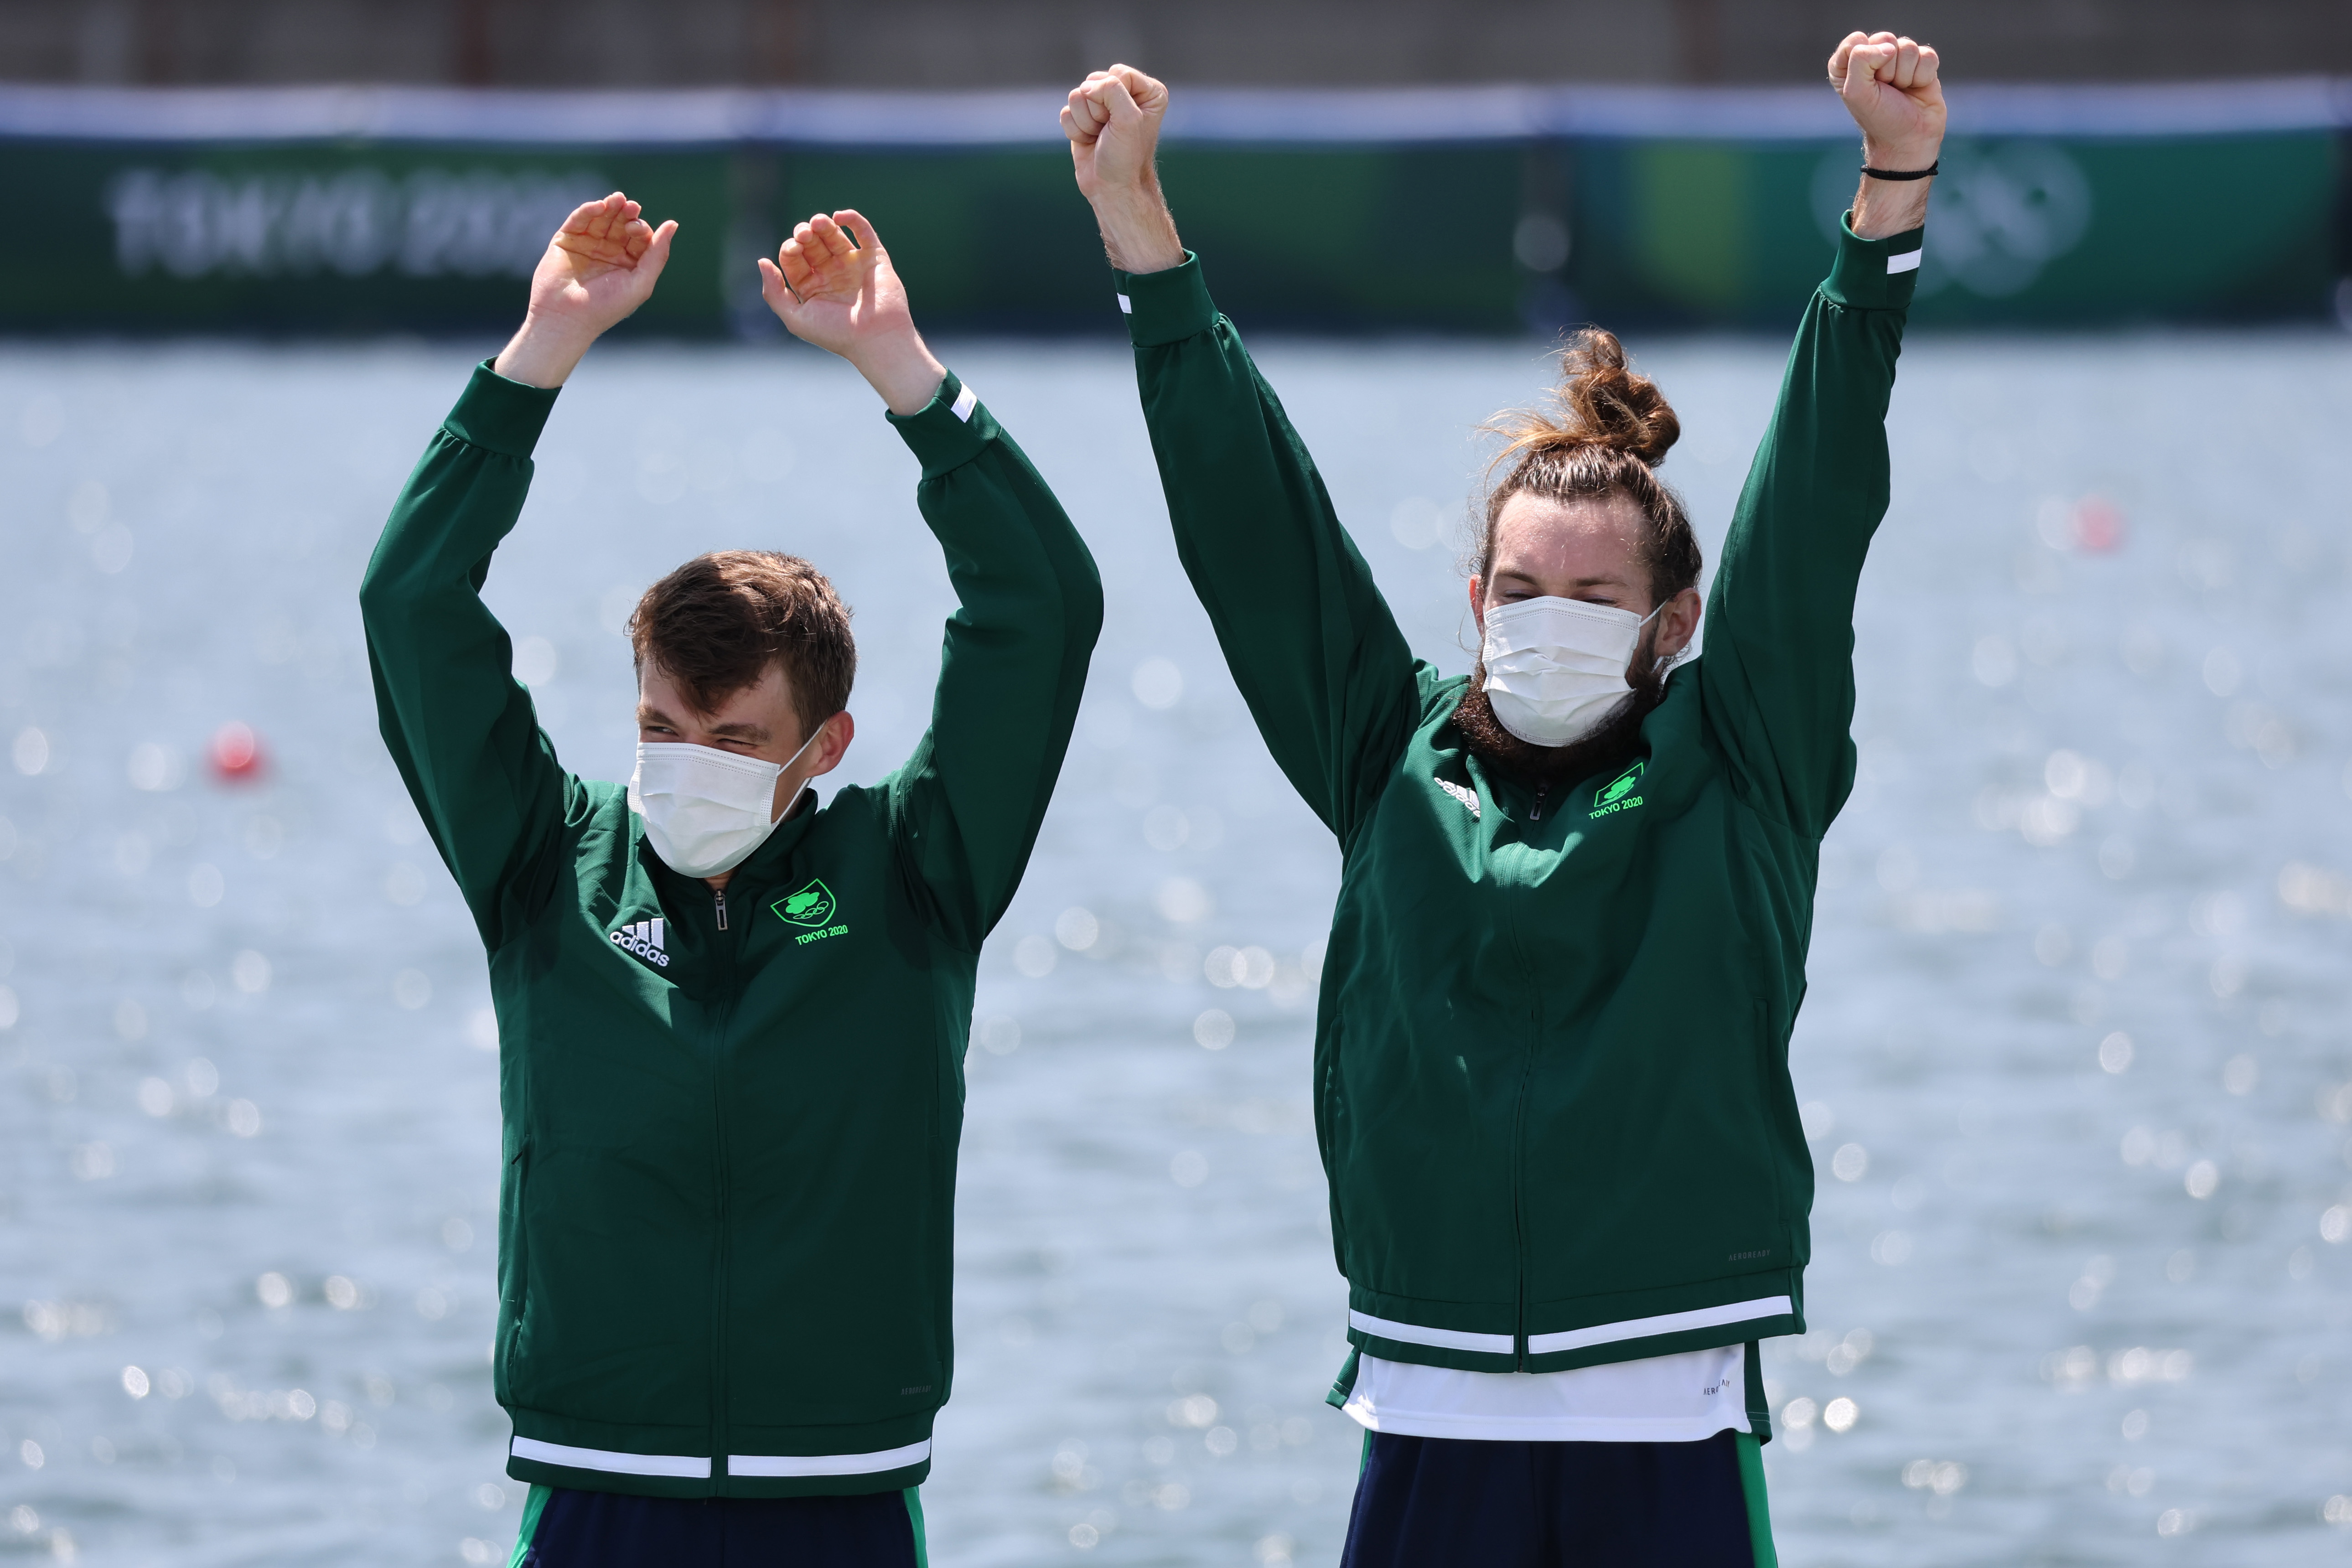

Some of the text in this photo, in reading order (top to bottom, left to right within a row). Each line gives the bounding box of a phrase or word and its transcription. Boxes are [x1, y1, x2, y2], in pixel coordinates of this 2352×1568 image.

[108, 170, 396, 275] TOKYO
[1588, 796, 1643, 819] TOKYO 2020
[795, 925, 848, 946] TOKYO 2020
[609, 931, 670, 967] adidas
[1728, 1249, 1770, 1262] AEROREADY
[901, 1385, 932, 1395] AEROREADY
